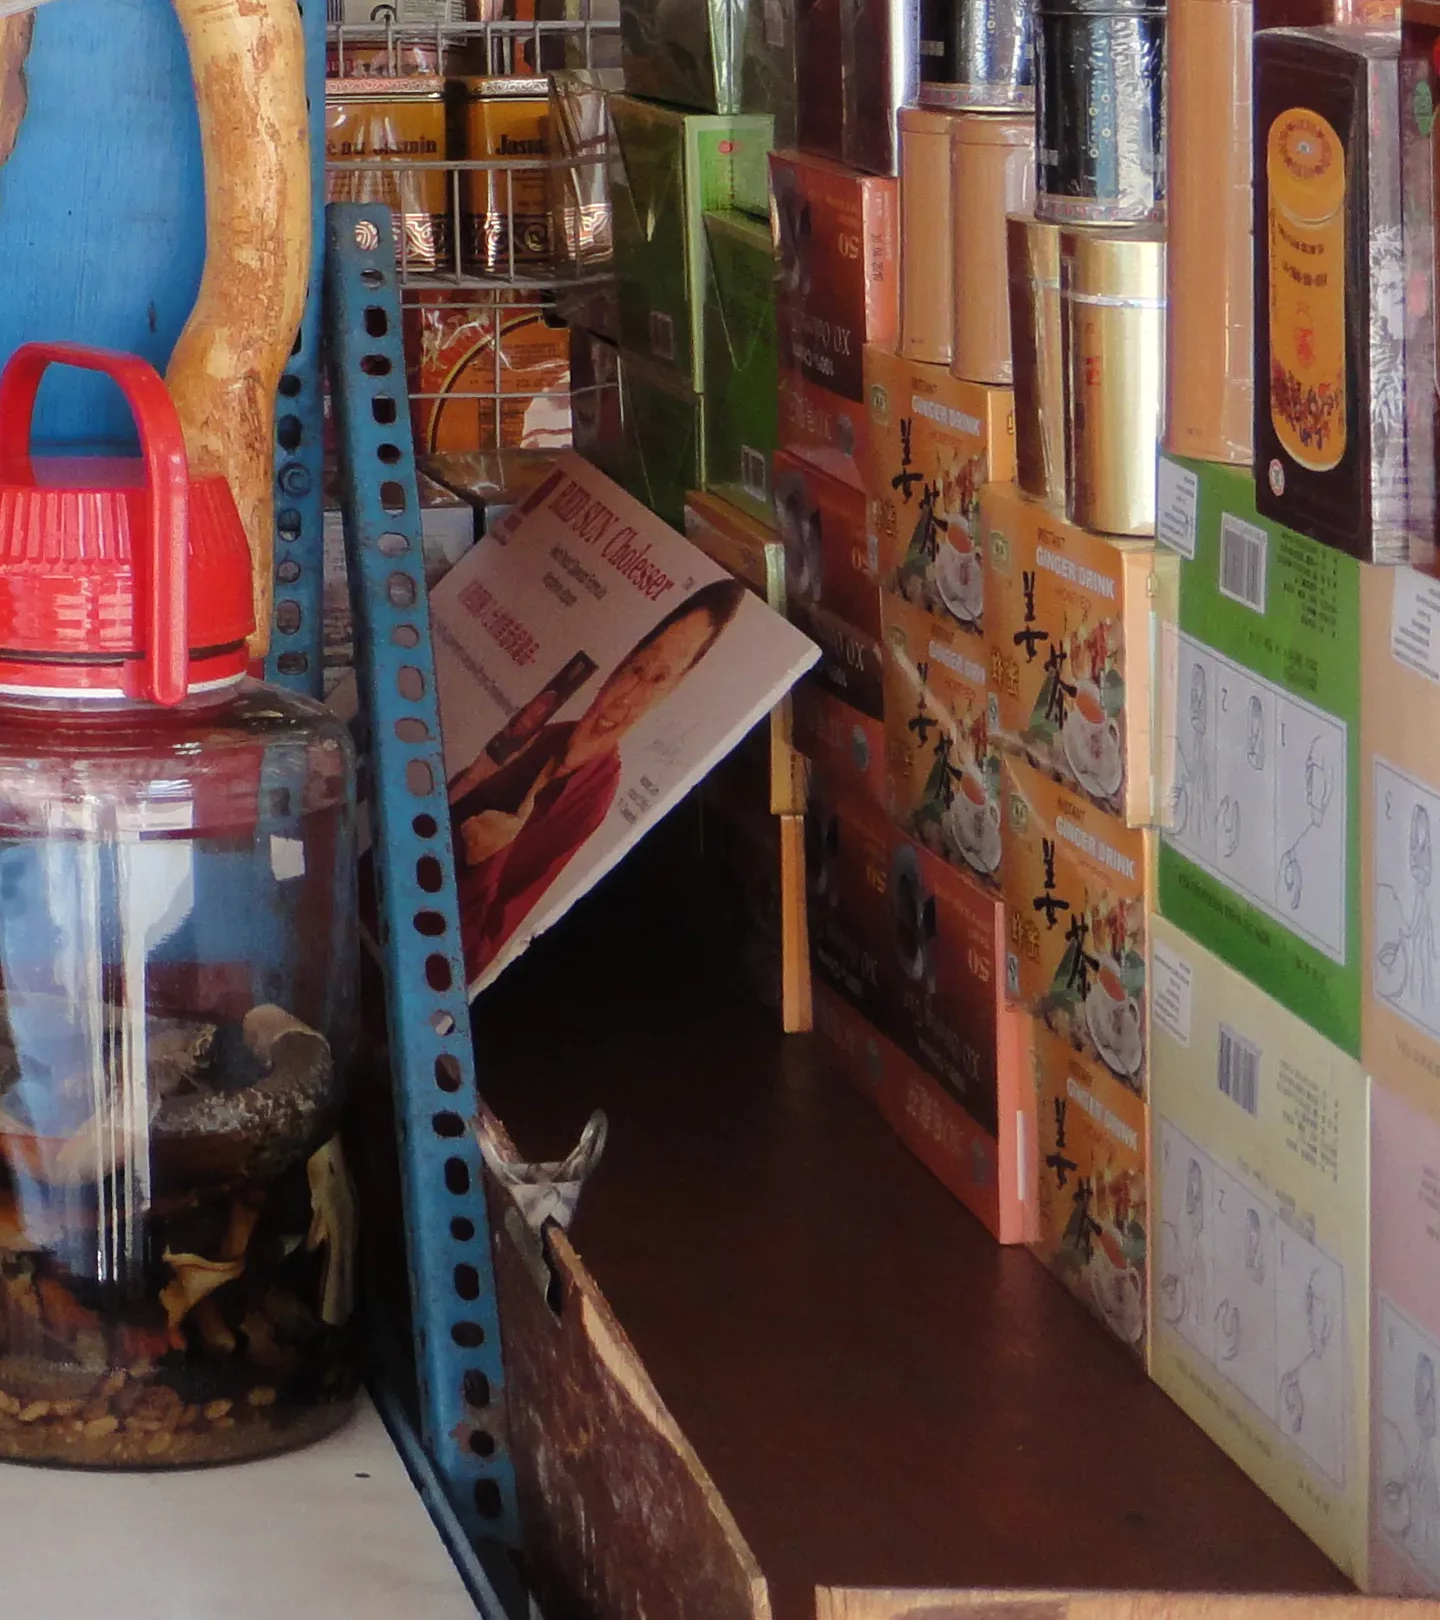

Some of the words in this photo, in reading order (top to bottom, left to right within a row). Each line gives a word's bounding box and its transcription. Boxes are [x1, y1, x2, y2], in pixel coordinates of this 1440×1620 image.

[912, 395, 948, 425] GINGER
[949, 410, 980, 437] DRINK
[601, 525, 675, 602] Cholesser
[1035, 545, 1078, 581] GINGER
[1079, 567, 1116, 601] DRINK
[1055, 815, 1097, 858] GINGER
[1098, 843, 1137, 881] DRINK
